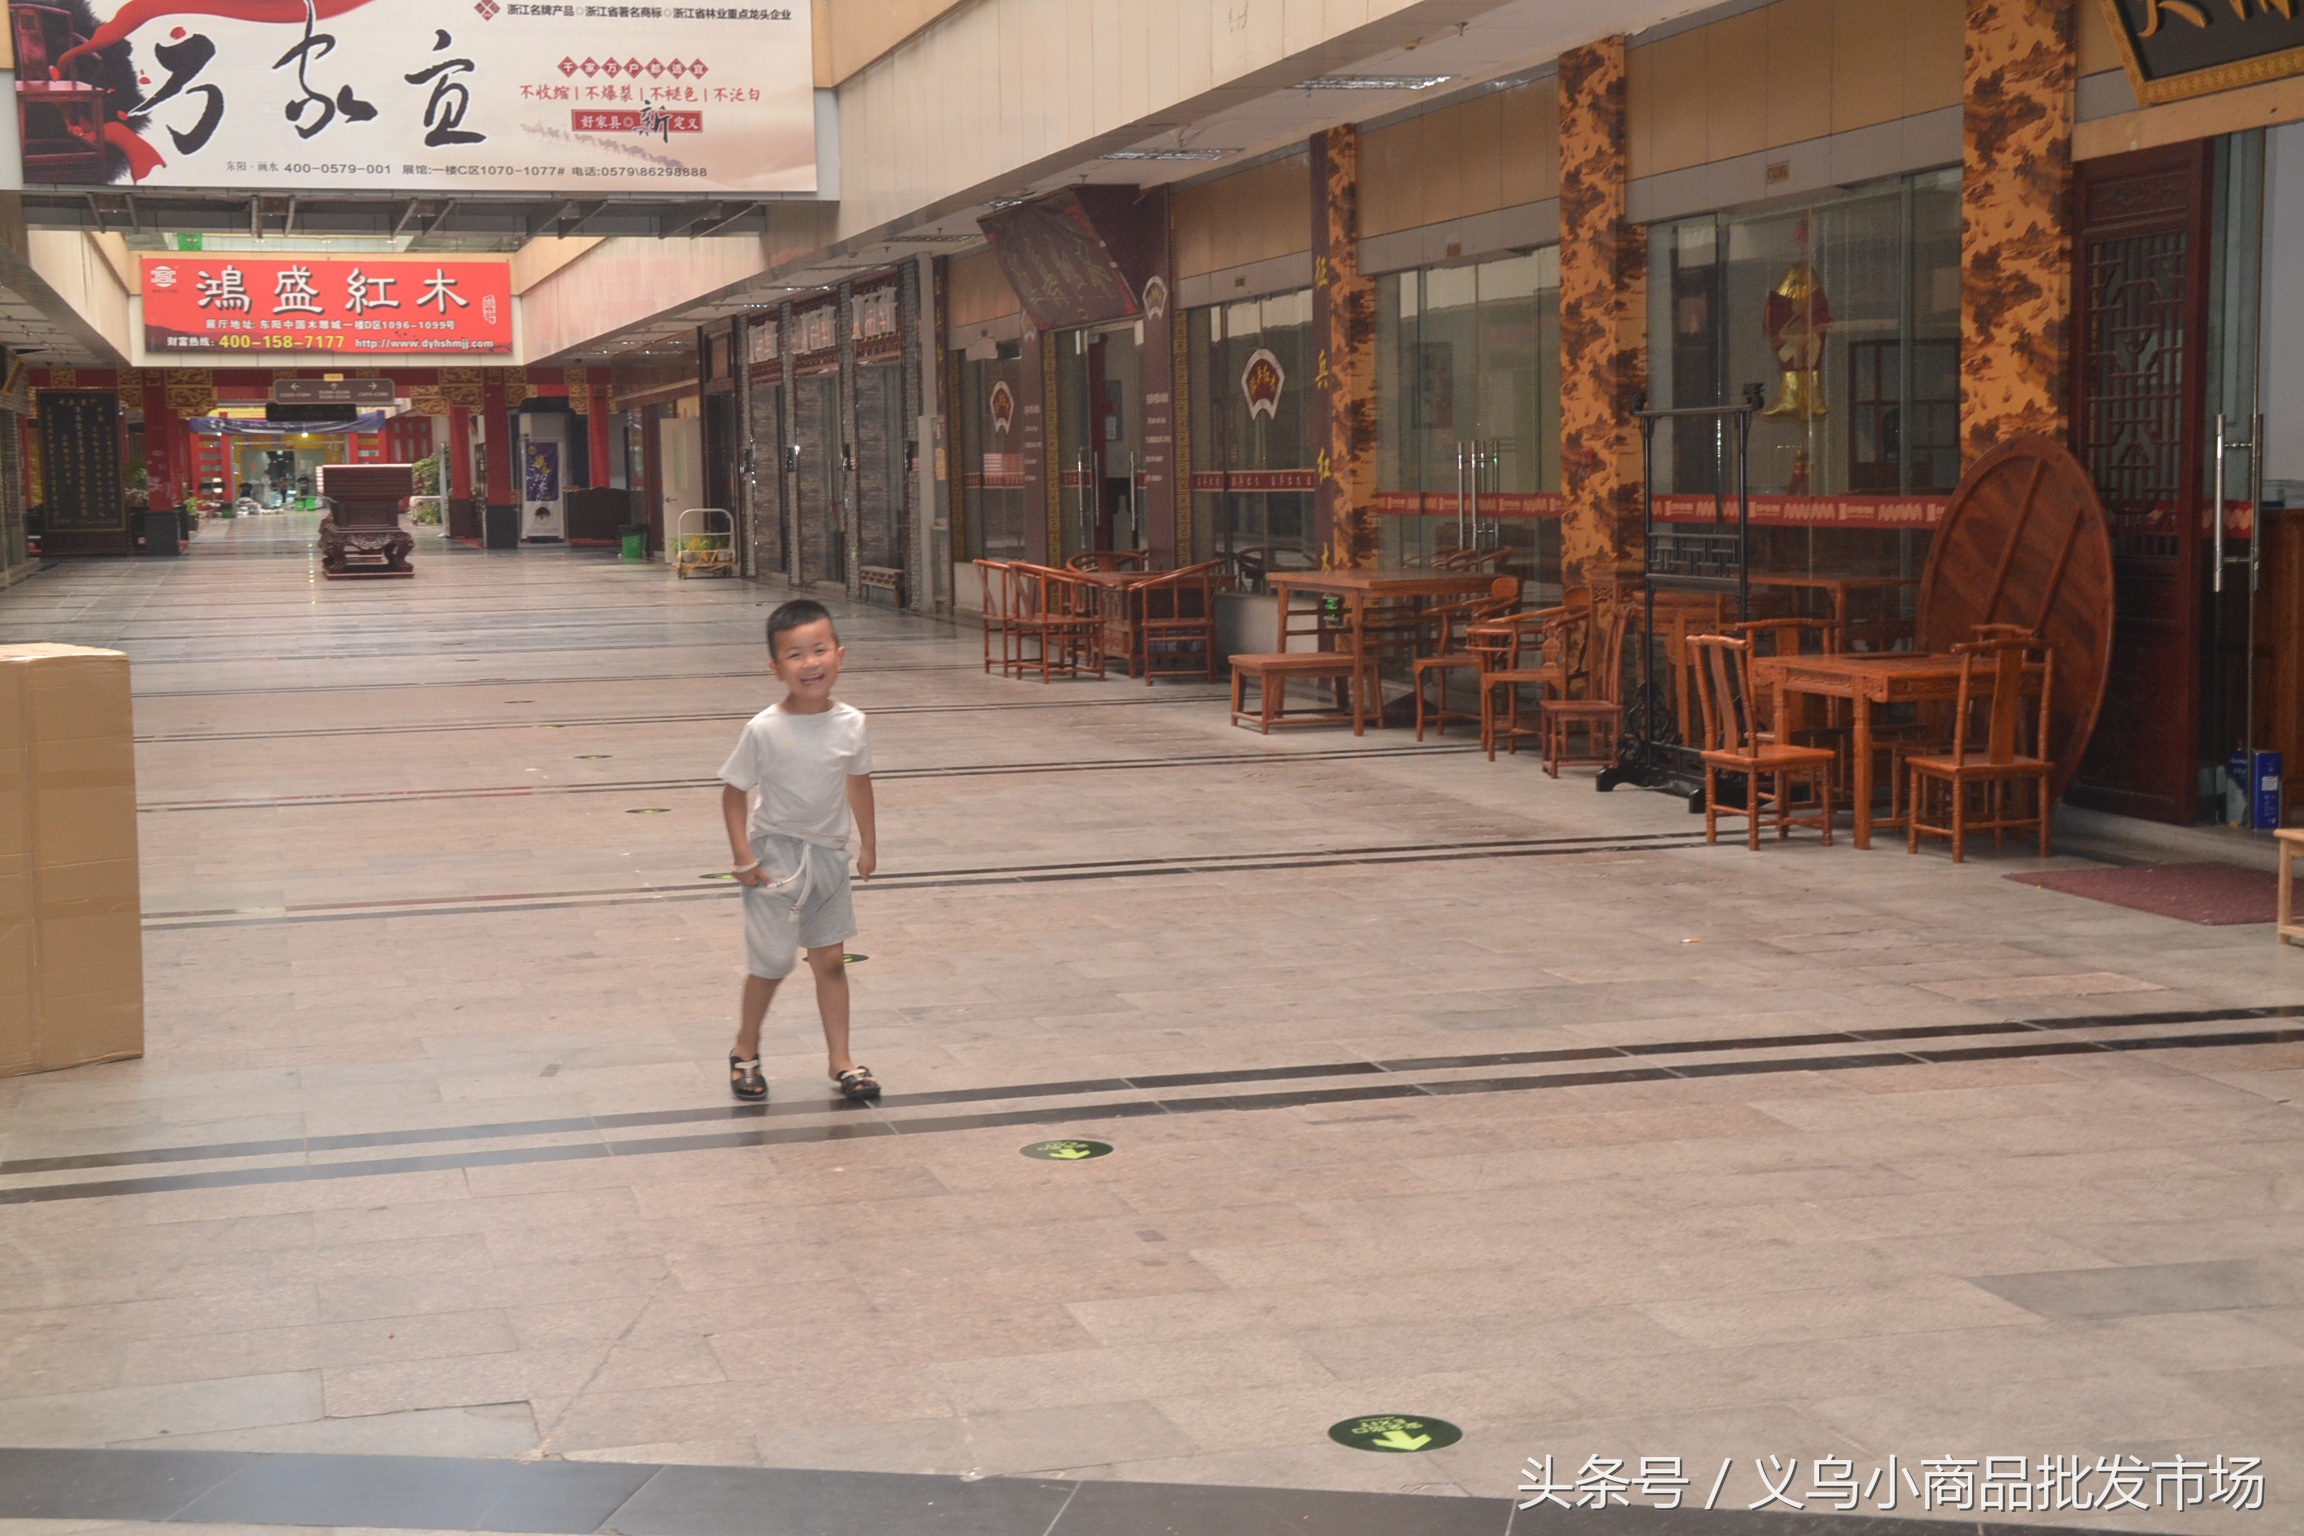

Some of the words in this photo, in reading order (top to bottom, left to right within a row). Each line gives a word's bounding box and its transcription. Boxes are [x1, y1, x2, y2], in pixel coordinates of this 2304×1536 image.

[507, 4, 575, 17] 浙江名牌产品
[585, 6, 663, 19] 浙江省著名商标
[672, 7, 792, 20] 浙江省林业重点龙头企业
[561, 60, 706, 77] 千家万户都适宜
[284, 163, 392, 175] 400-0579-001
[196, 264, 470, 316] 鴻盛紅木
[218, 334, 346, 350] 400-158-7177
[354, 338, 494, 351] http://www.dyhshmjj.com
